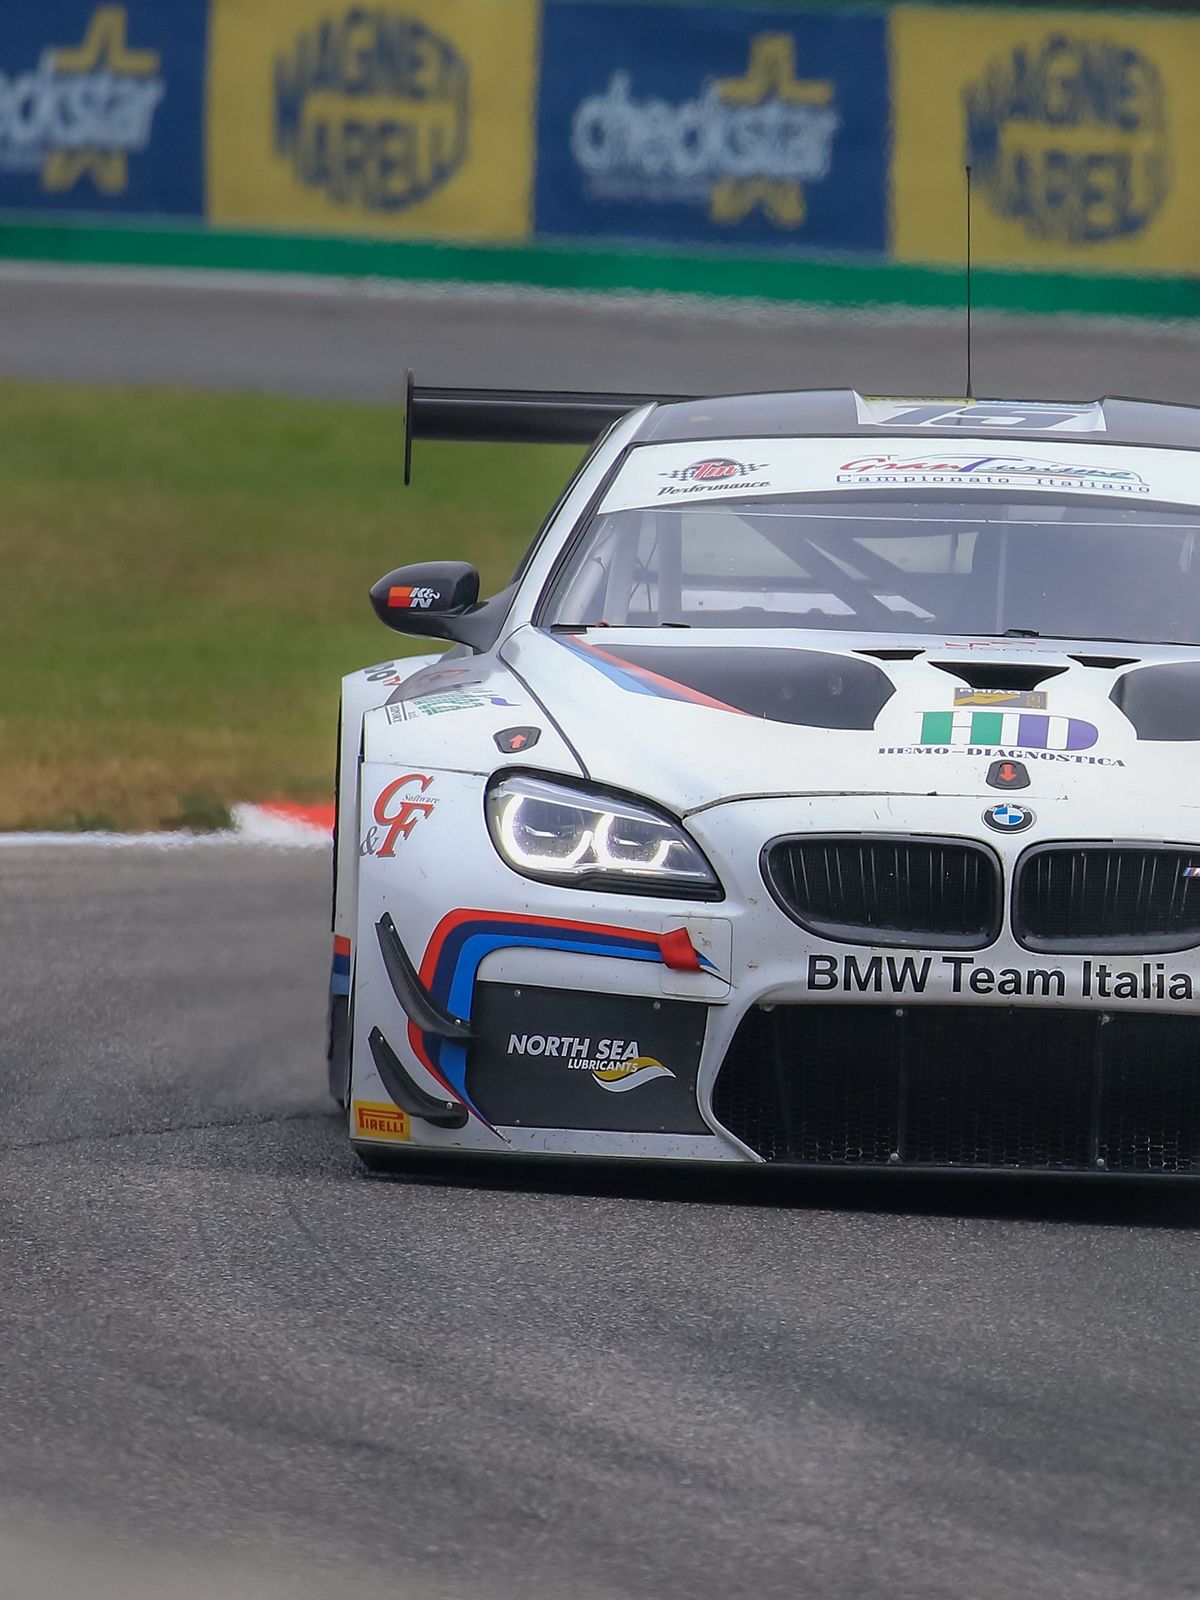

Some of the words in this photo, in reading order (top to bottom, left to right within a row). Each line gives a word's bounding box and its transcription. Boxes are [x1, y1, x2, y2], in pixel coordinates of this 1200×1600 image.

[657, 482, 772, 496] Performance
[836, 474, 1010, 484] Campionato
[1037, 479, 1150, 492] Italiano
[807, 955, 931, 992] BMW
[942, 956, 1066, 996] Team
[1081, 961, 1194, 1000] Italia
[507, 1034, 590, 1058] NORTH
[595, 1039, 640, 1060] SEA
[567, 1059, 639, 1073] LUBRICANTS
[358, 1108, 404, 1133] PIRELLI
